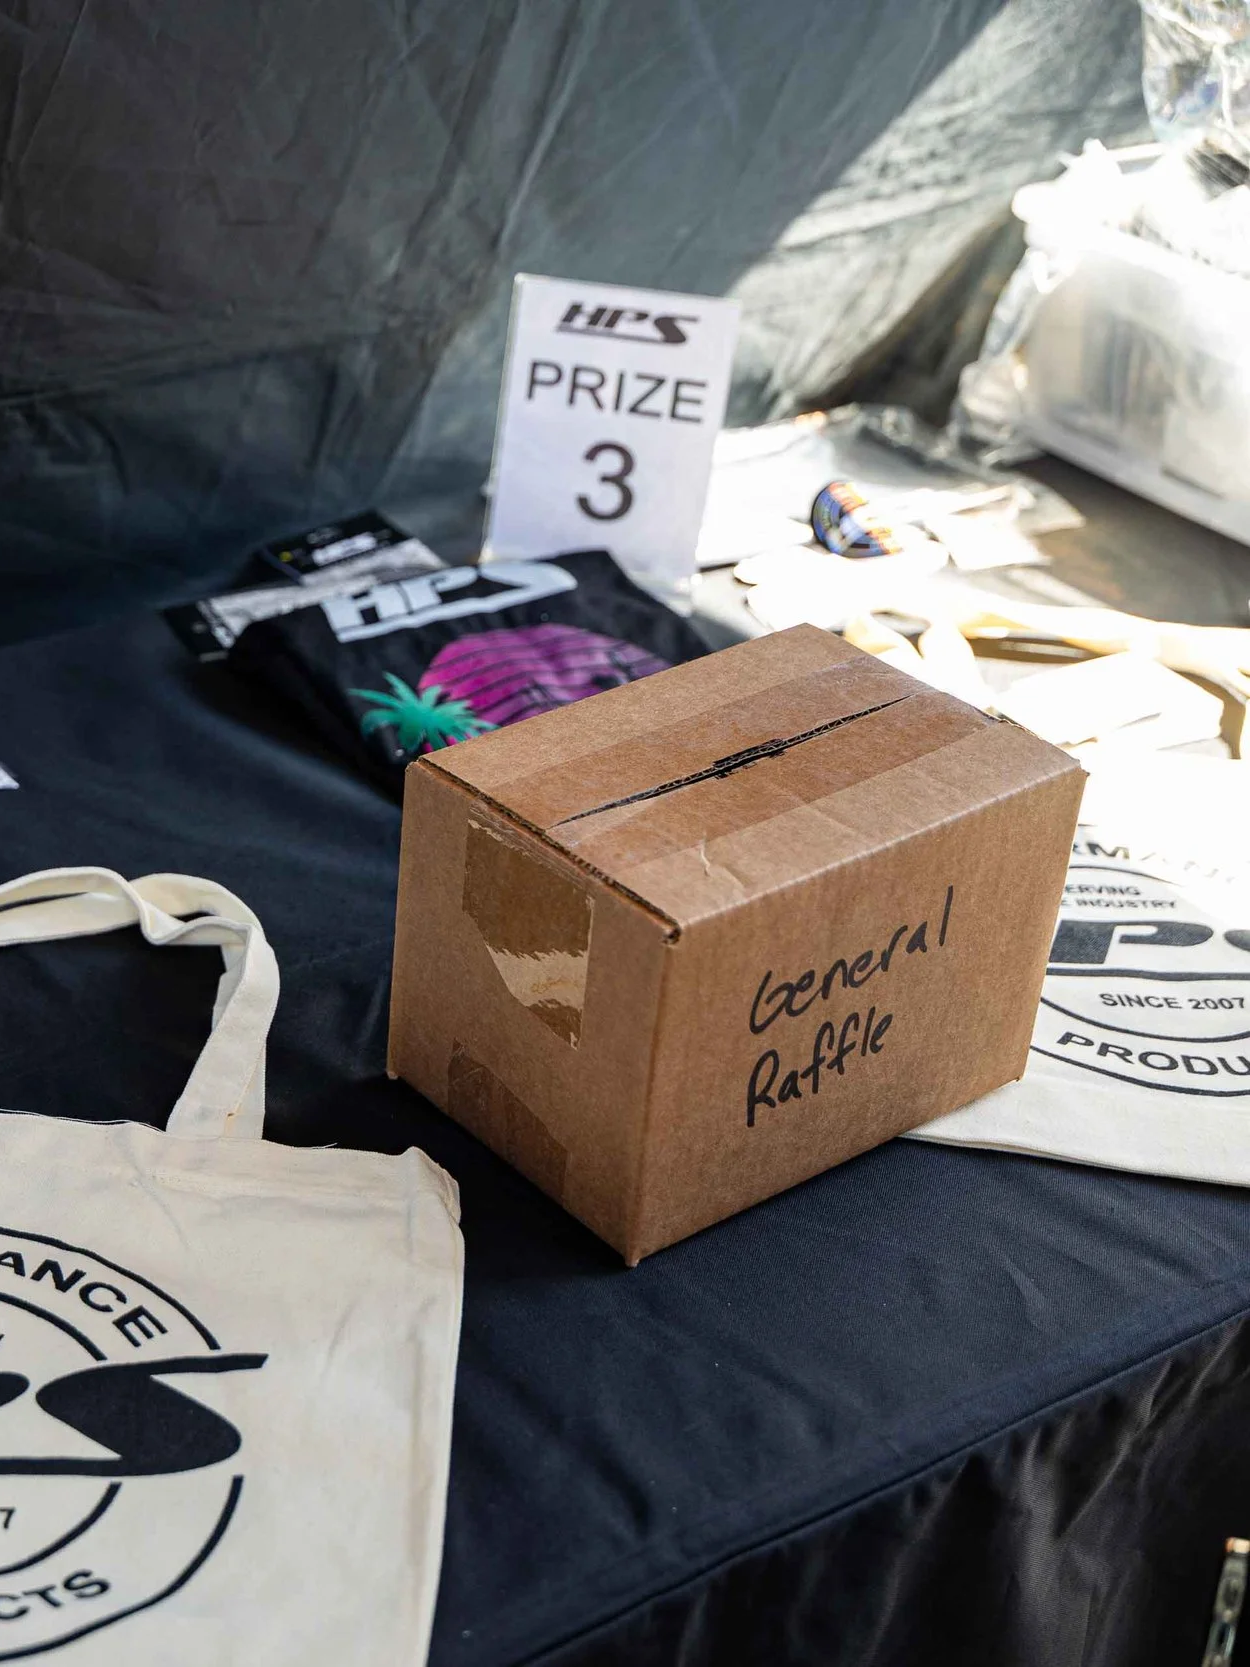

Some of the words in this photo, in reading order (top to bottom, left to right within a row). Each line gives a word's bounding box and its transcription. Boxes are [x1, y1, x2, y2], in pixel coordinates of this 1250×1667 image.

[556, 303, 702, 347] HPS
[526, 359, 708, 425] PRIZE
[576, 441, 636, 521] 3
[1064, 884, 1141, 896] ERVING
[750, 885, 955, 1034] General
[1099, 992, 1183, 1010] SINCE
[1187, 997, 1246, 1011] 2007
[746, 1007, 893, 1128] Raffle
[1056, 1031, 1250, 1076] PRODU
